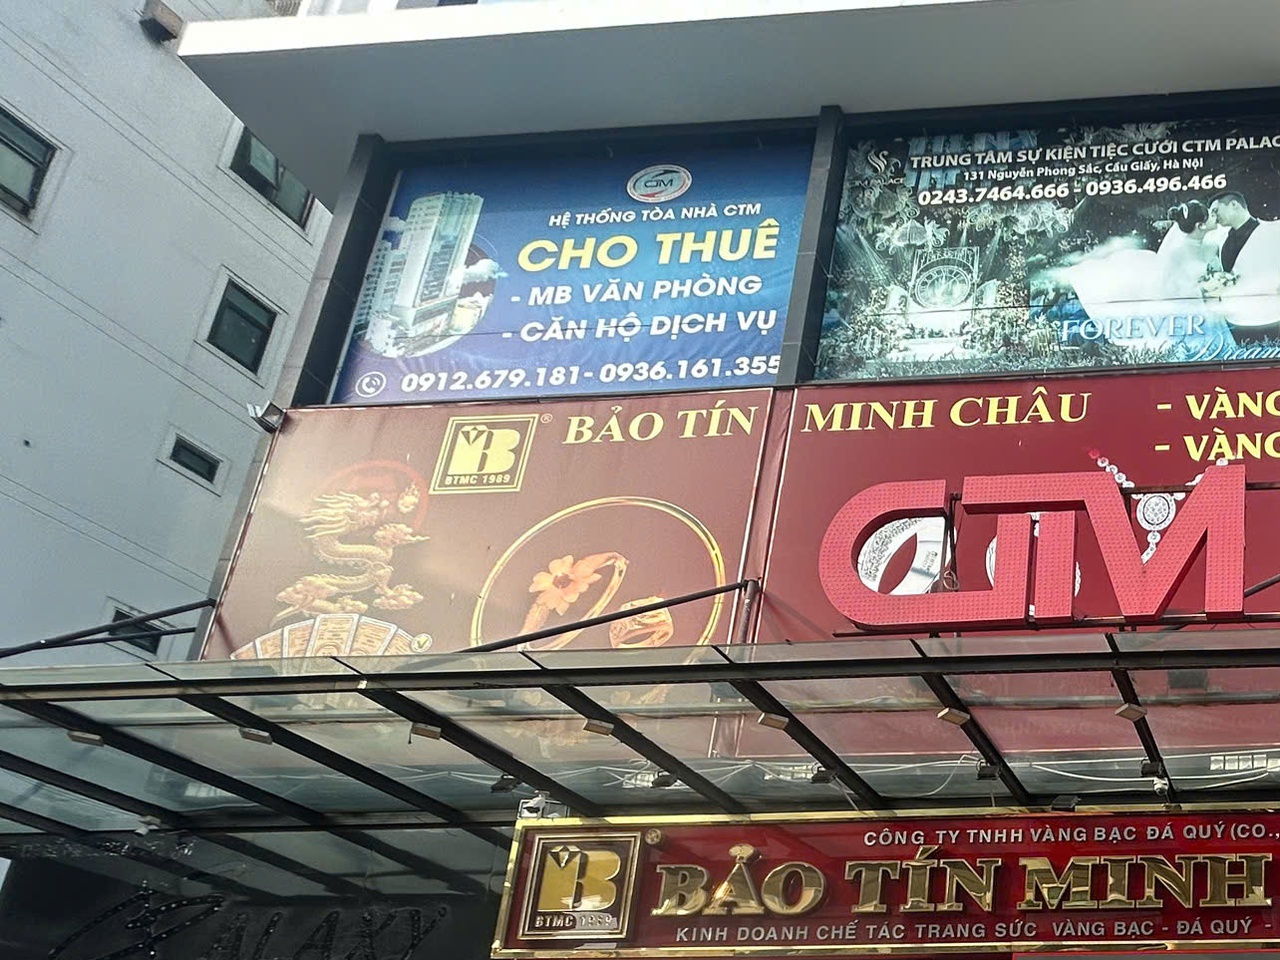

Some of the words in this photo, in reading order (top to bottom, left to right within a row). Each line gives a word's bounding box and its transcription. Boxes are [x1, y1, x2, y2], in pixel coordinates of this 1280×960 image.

[910, 153, 971, 168] TRUNG
[976, 149, 1012, 165] TÂM
[1016, 147, 1043, 165] SỰ
[1046, 144, 1086, 162] KIỆN
[1090, 143, 1128, 160] TIỆC
[1133, 139, 1178, 155] CƯỚI
[1182, 138, 1221, 152] CTM
[964, 171, 984, 181] 131
[988, 168, 1034, 182] Nguyễn
[1037, 165, 1075, 177] Phong
[1163, 158, 1180, 169] Hà
[1183, 157, 1204, 169] Nội
[918, 183, 1069, 205] 0243.7464.666
[1086, 174, 1227, 196] 0936.496.466
[549, 211, 570, 228] HỆ
[575, 206, 636, 225] THỐNG
[641, 206, 675, 221] TÒA
[681, 203, 718, 219] NHÀ
[723, 203, 761, 216] CTM
[517, 235, 638, 272] CHO
[656, 218, 780, 265] THUÊ
[528, 285, 572, 306] MB
[582, 276, 643, 302] VĂN
[652, 271, 762, 298] PHÒNG
[520, 317, 587, 342] CĂN
[595, 312, 642, 342] HỘ
[651, 313, 731, 340] DỊCH
[737, 309, 777, 333] VỤ
[1061, 315, 1205, 342] FOREVER
[599, 355, 780, 383] 0936.161.355
[562, 407, 665, 444] BẢO
[677, 401, 758, 439] TÍN
[801, 398, 939, 433] MINH
[949, 386, 1092, 427] CHÂU
[445, 475, 478, 485] BTMC
[482, 474, 511, 484] 1989
[818, 464, 1247, 626] CTM
[863, 823, 925, 846] CÔNG
[936, 829, 960, 845] TY
[966, 828, 1024, 844] TNHH
[1029, 819, 1087, 843] VÀNG
[1093, 825, 1137, 844] BẠC
[1146, 820, 1175, 841] ĐÁ
[649, 843, 828, 918] BẢO
[844, 845, 1003, 915] TÍN
[1016, 852, 1273, 911] MINH
[534, 914, 574, 928] BTMC
[675, 926, 728, 943] KINH
[736, 924, 808, 942] DOANH
[816, 917, 858, 941] CHẾ
[867, 919, 906, 940] TÁC
[916, 922, 987, 939] TRANG
[995, 916, 1037, 938] SỨC
[1052, 915, 1109, 937] VÀNG
[1113, 919, 1153, 939] BẠC
[1176, 914, 1204, 936] ĐÁ
[1209, 913, 1253, 936] QUÝ
